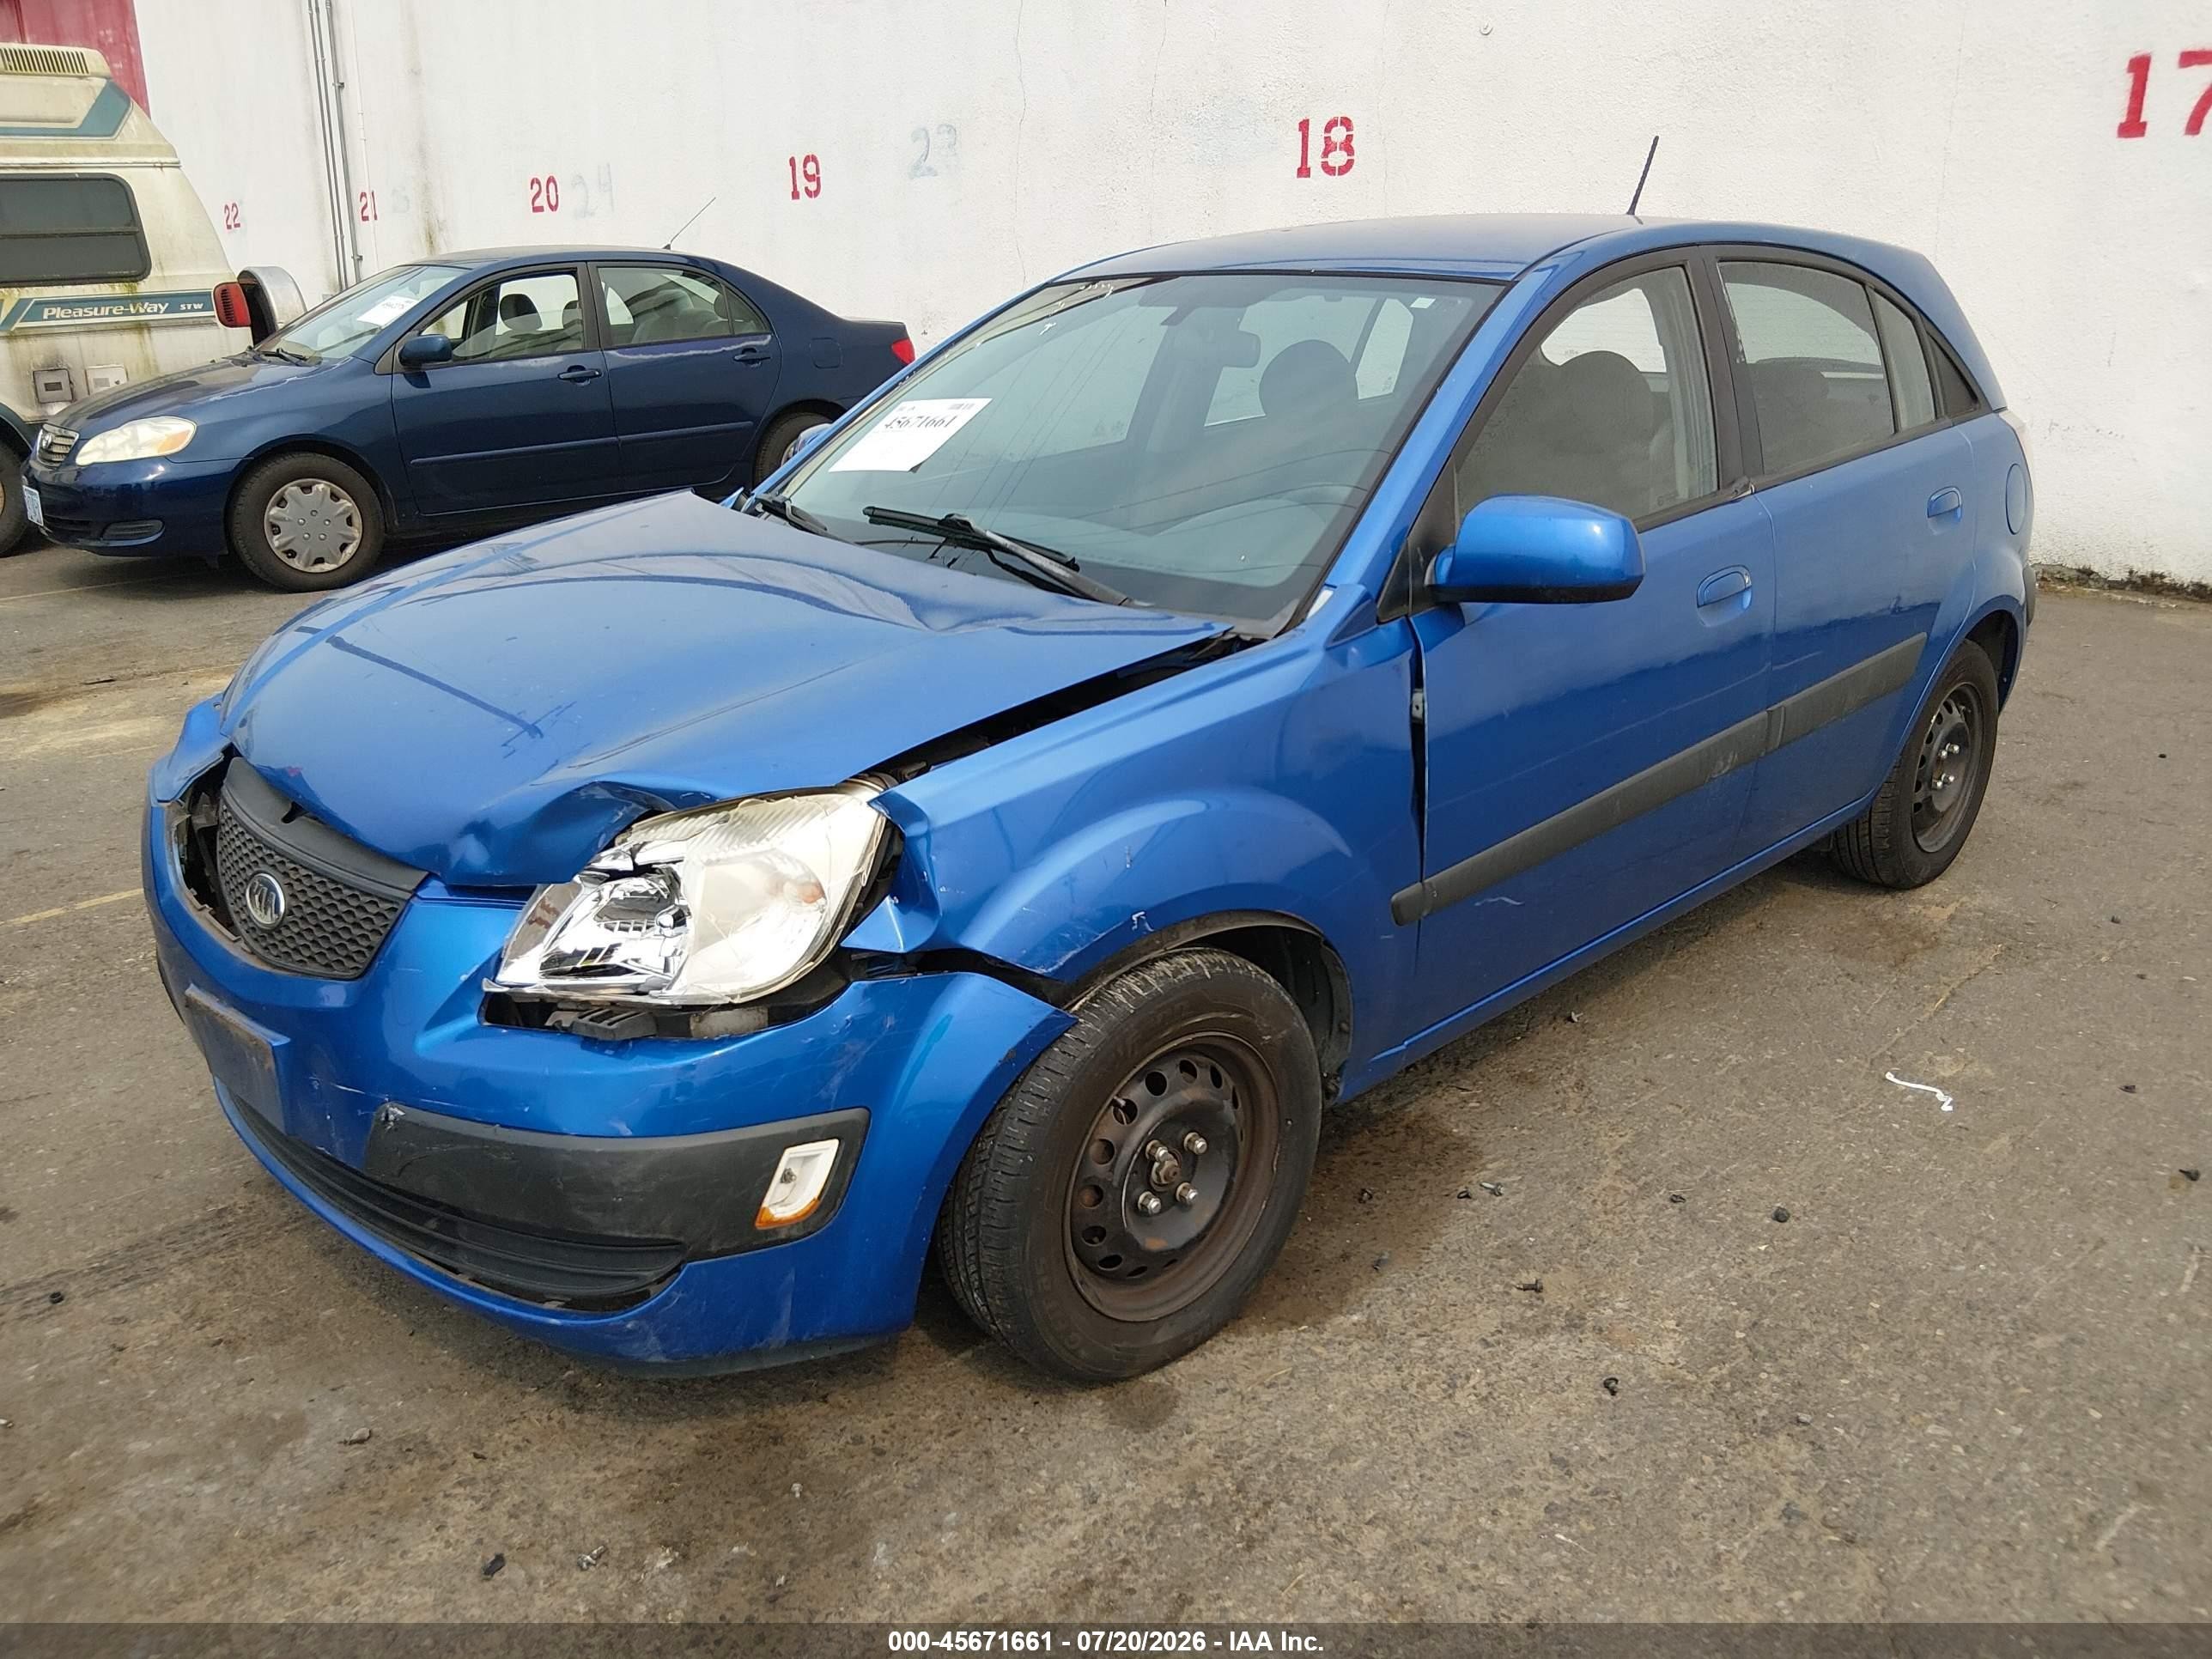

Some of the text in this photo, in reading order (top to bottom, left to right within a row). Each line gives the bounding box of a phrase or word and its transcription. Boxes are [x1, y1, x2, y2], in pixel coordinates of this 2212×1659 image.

[2117, 49, 2212, 138] 17
[1297, 116, 1355, 178] 18
[530, 175, 559, 213] 20
[789, 154, 821, 200] 19
[224, 203, 241, 230] 22
[359, 190, 378, 222] 21
[43, 301, 169, 319] Pleasure-Way
